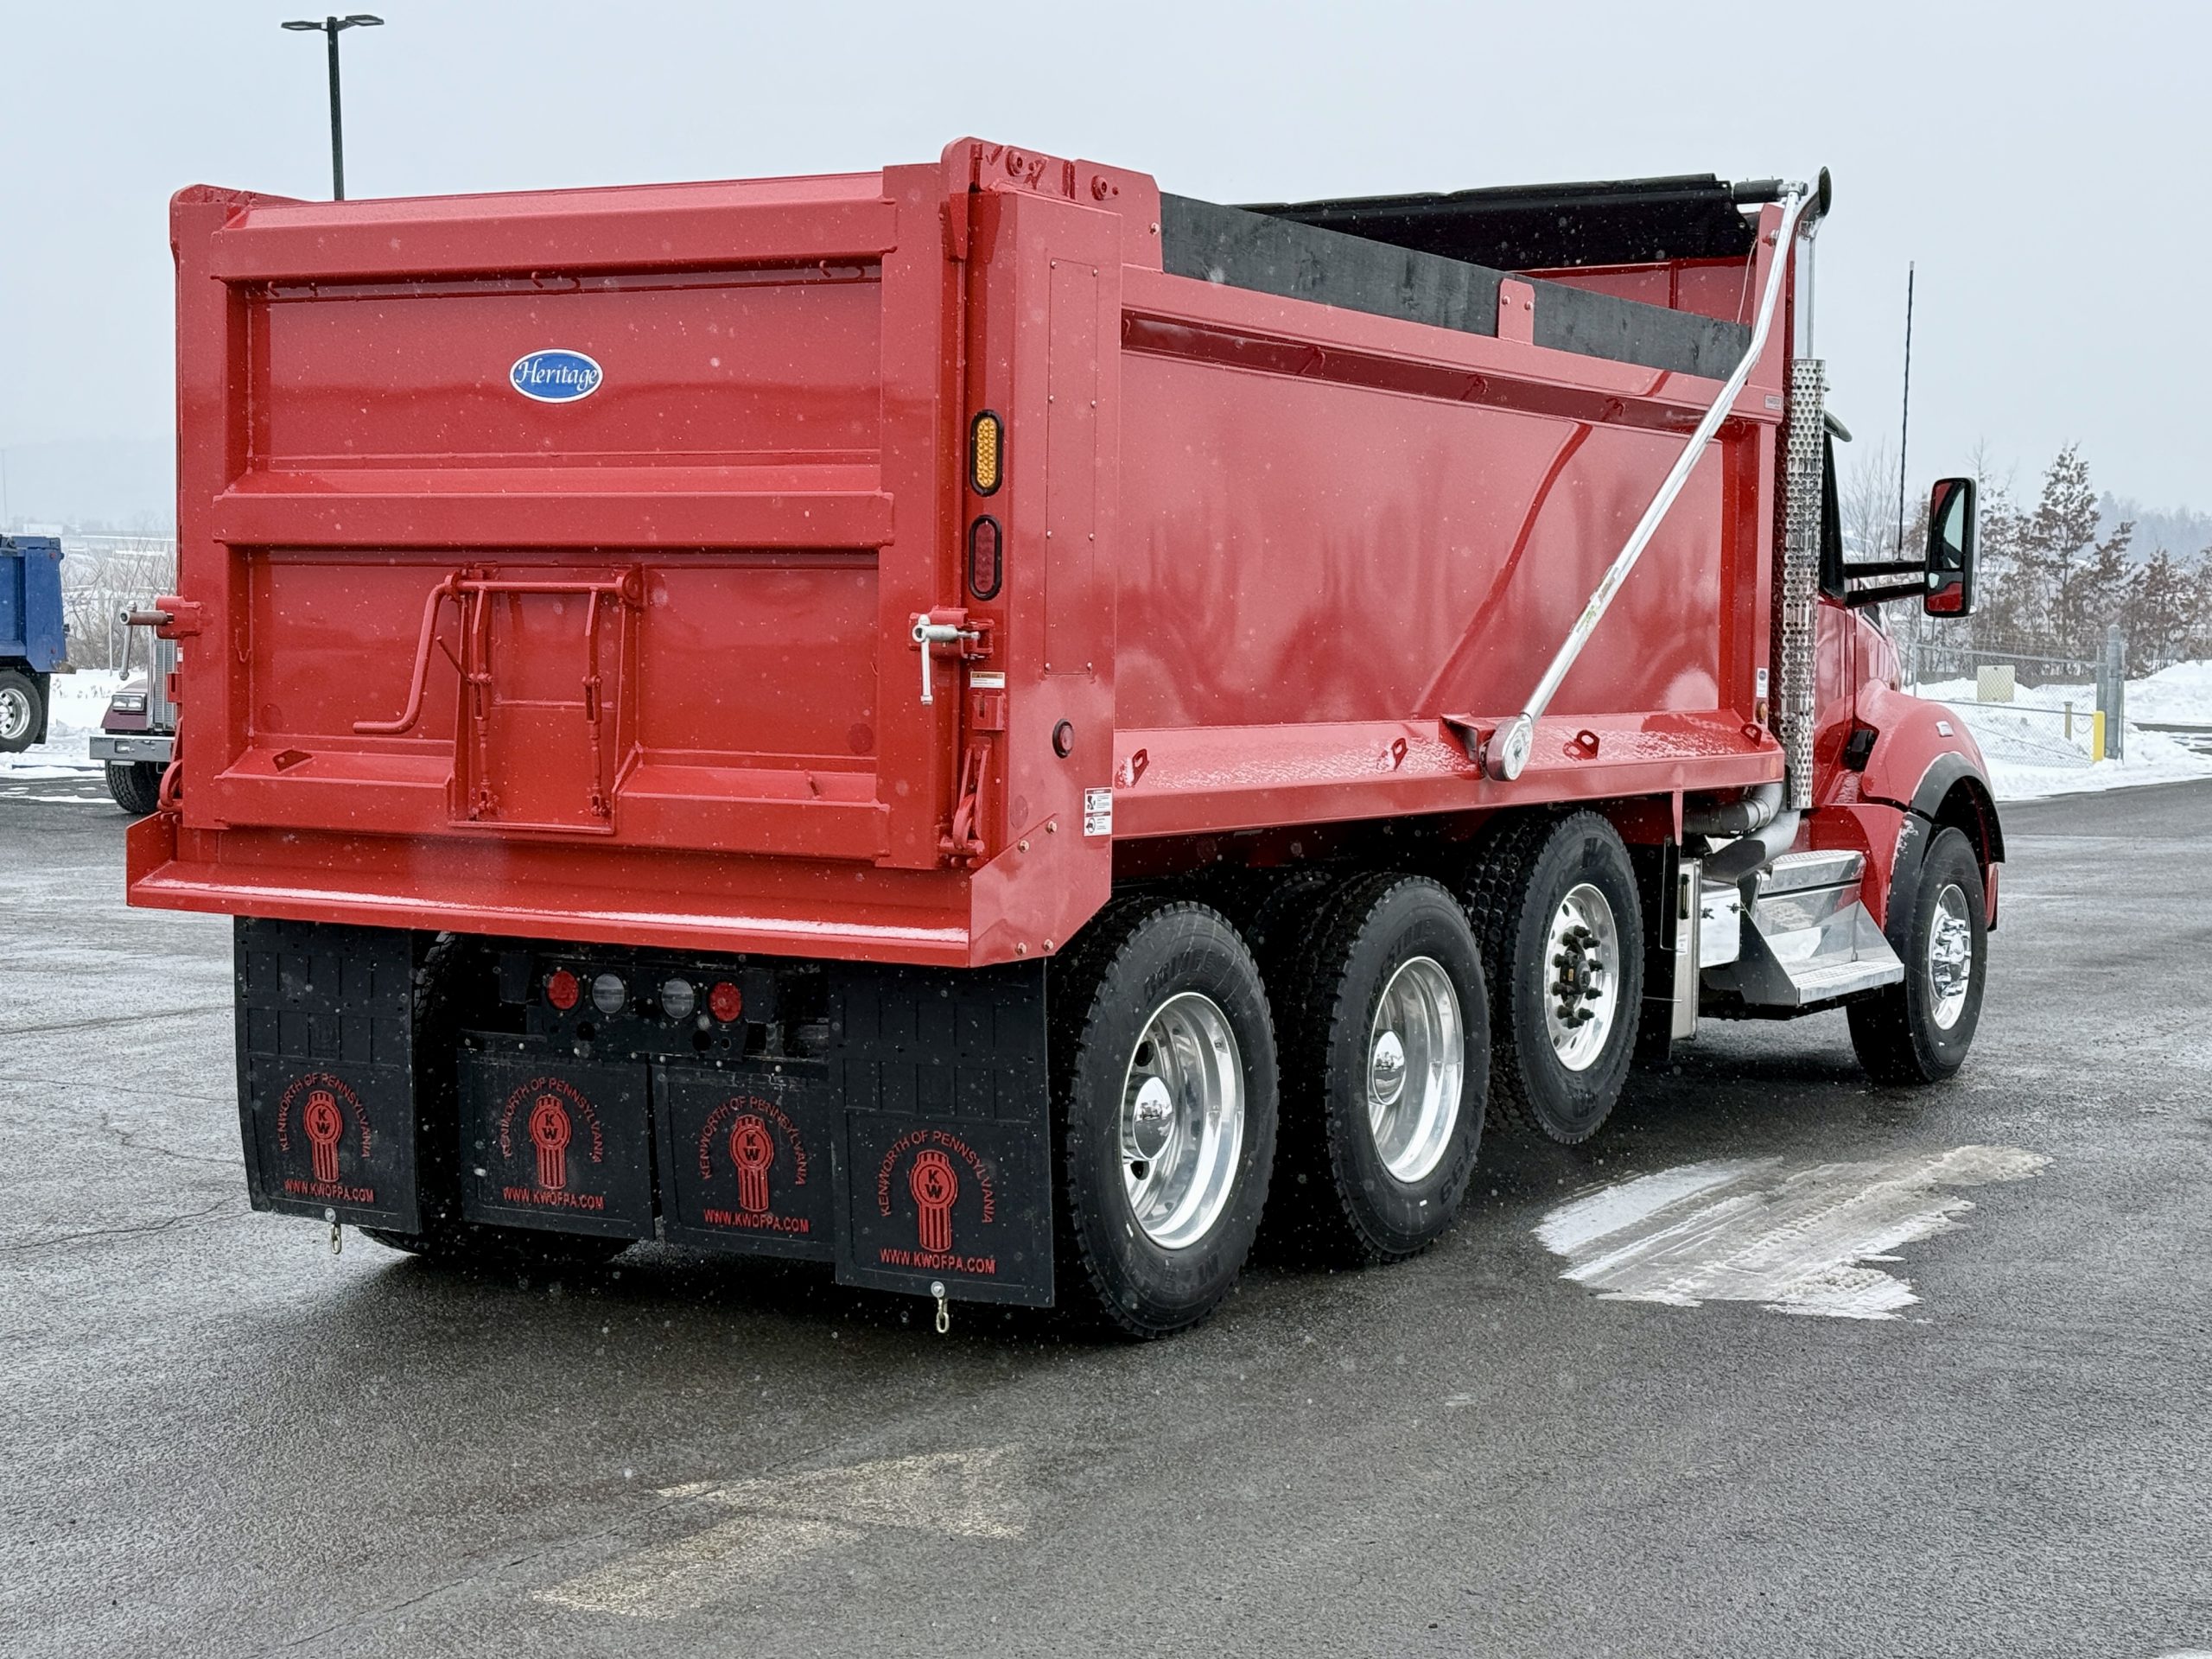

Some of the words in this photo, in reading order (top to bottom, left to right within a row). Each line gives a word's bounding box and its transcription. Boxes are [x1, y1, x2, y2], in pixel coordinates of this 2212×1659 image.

[515, 358, 598, 391] Heritage
[277, 1079, 302, 1152] KENWORTH
[304, 1072, 319, 1086] OF
[321, 1073, 372, 1158] PENNSYLVANIA
[549, 1077, 603, 1163] PENNSYLVANIA
[700, 1103, 728, 1179] KENWORTH
[730, 1096, 747, 1111] OF
[750, 1096, 808, 1185] PENNSYLVANIA
[284, 1179, 374, 1203] WWW.KWOFPA.COM
[878, 1139, 911, 1217] KENWORTH
[912, 1130, 929, 1145] OF
[932, 1130, 995, 1224] PENNSYLVANIA
[504, 1186, 604, 1210] WWW.KWOFPA.COM
[704, 1209, 810, 1233] WWW.KWOFPA.COM
[880, 1249, 996, 1274] WWW.KWOFPA.COM
